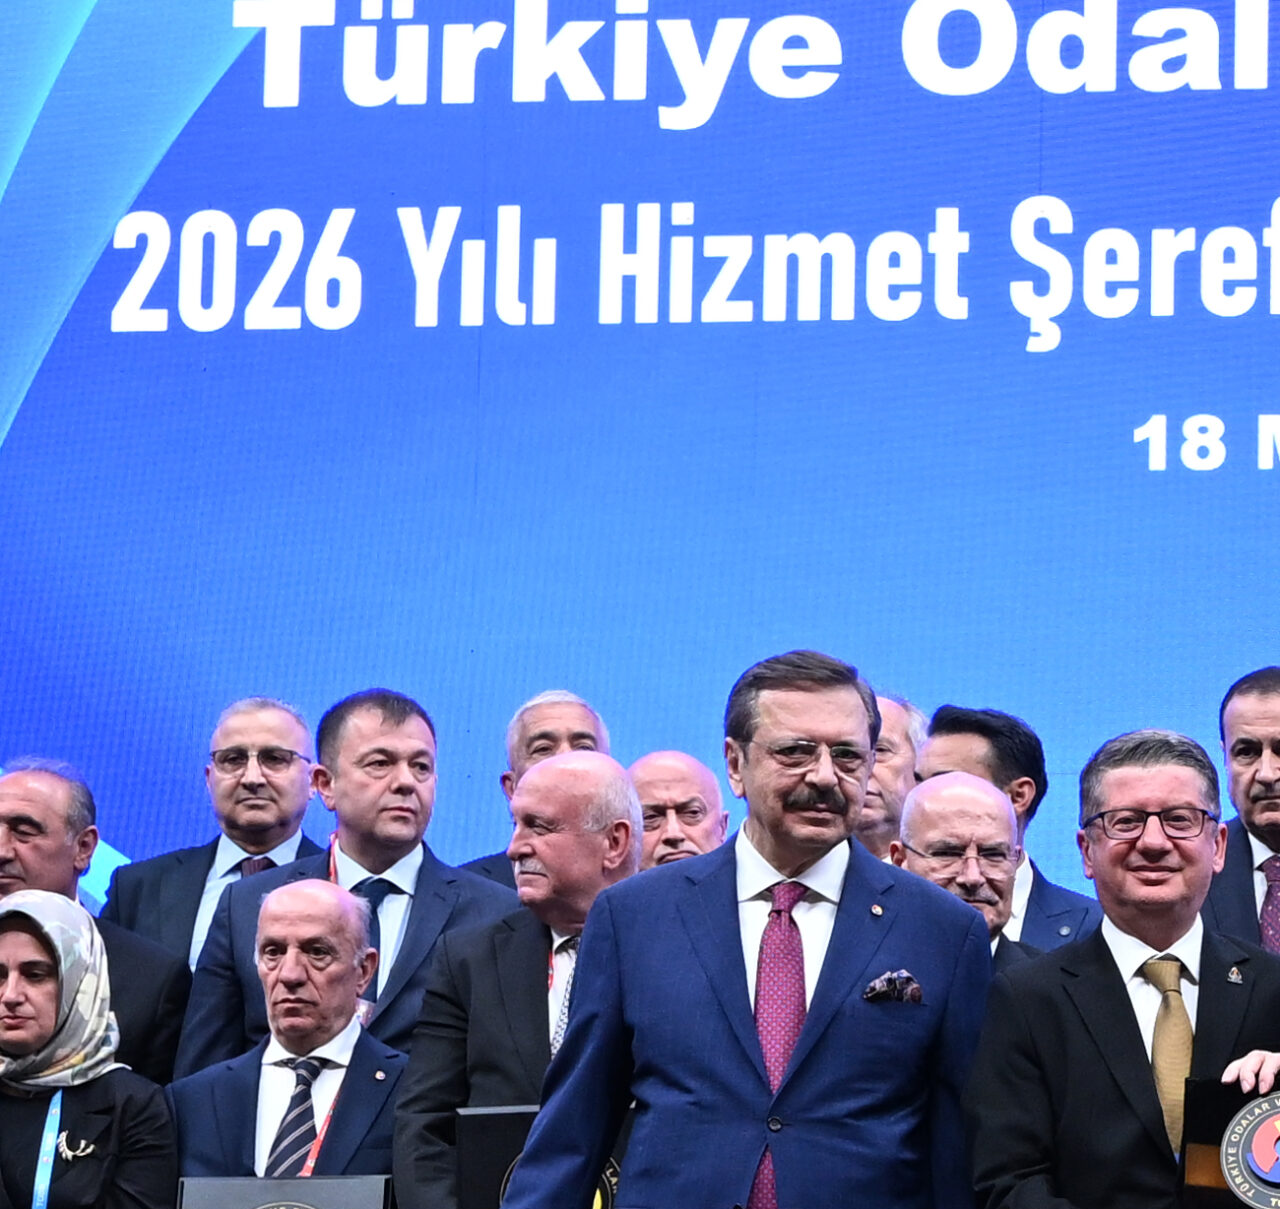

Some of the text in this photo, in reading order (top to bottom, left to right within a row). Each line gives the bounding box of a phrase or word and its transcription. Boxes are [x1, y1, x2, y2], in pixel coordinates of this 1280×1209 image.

[233, 0, 842, 130] Türkiye
[111, 208, 362, 332] 2026
[397, 205, 556, 327] Yılı
[599, 202, 970, 324] Hizmet
[1133, 414, 1226, 471] 18
[1231, 1102, 1271, 1142] ODALAR
